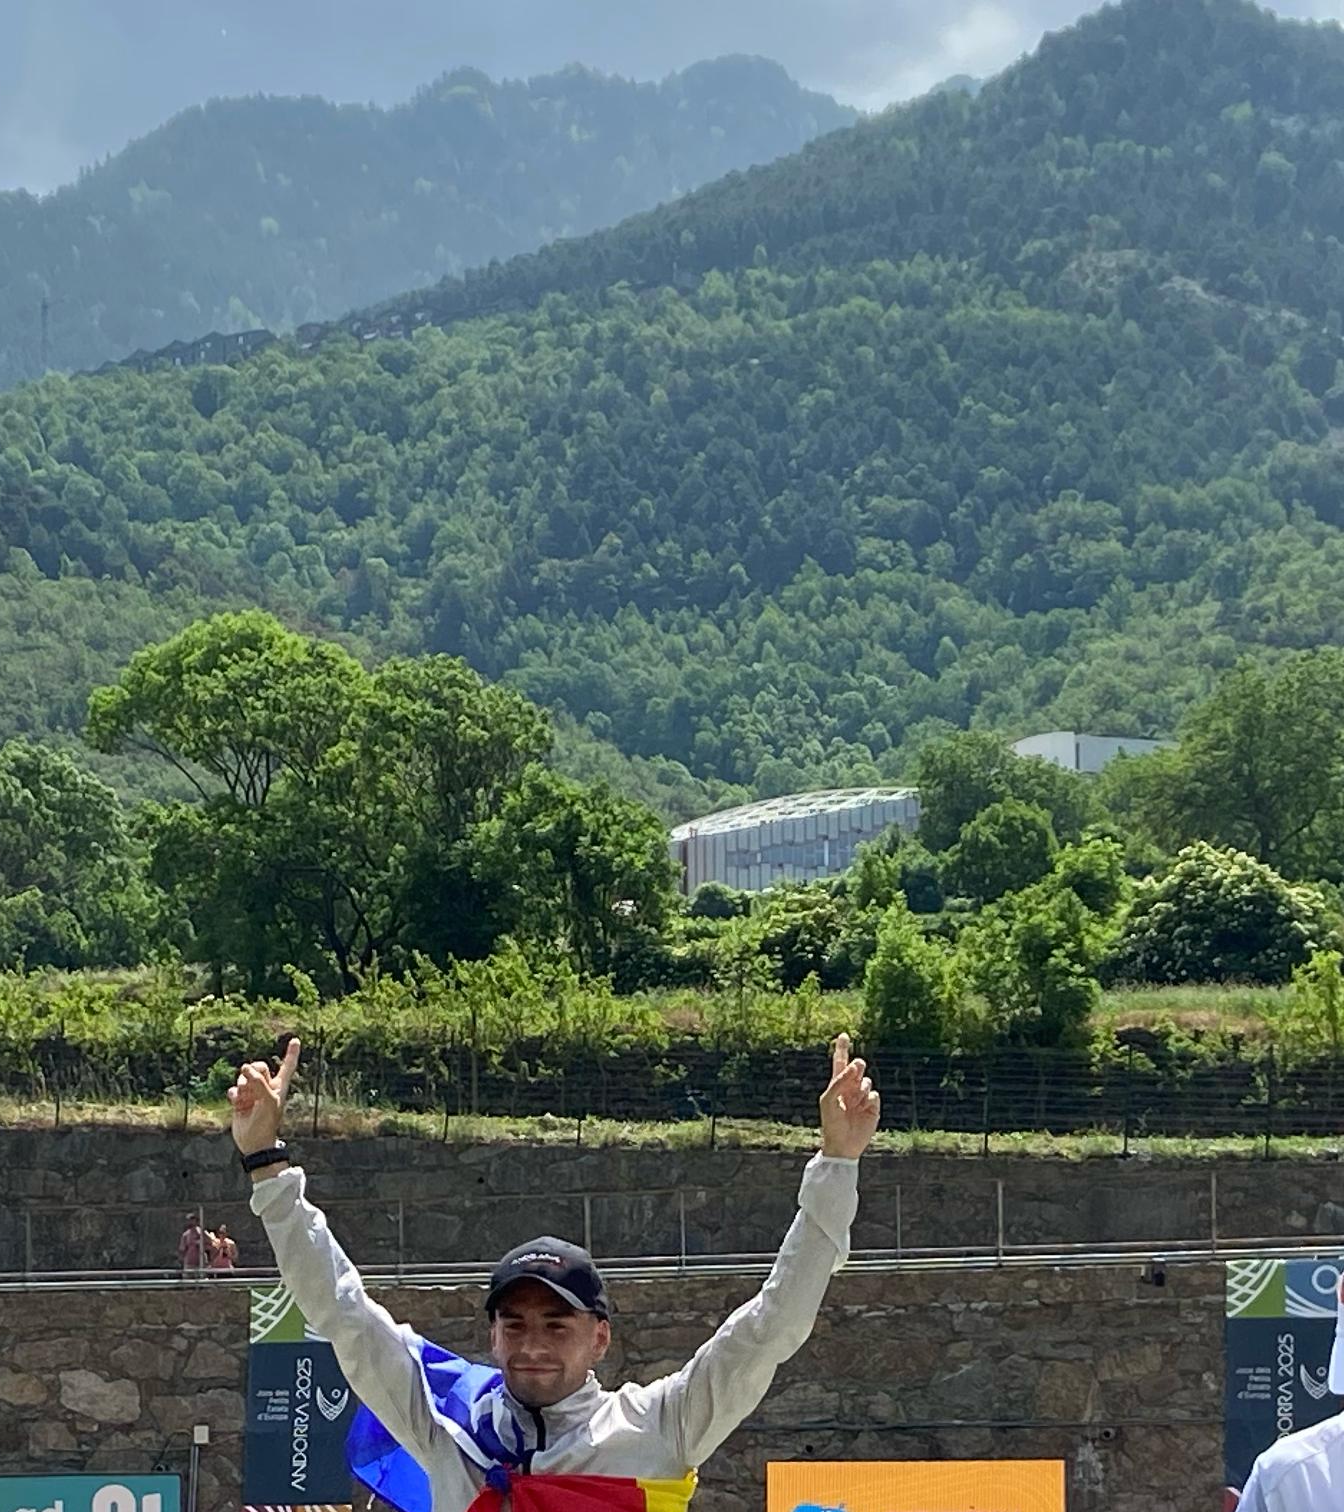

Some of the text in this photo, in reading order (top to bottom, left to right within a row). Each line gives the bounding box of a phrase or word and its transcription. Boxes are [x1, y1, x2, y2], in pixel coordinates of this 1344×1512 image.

[291, 1358, 312, 1491] ANDORRA 2025
[1277, 1334, 1294, 1439] ORRA 2025
